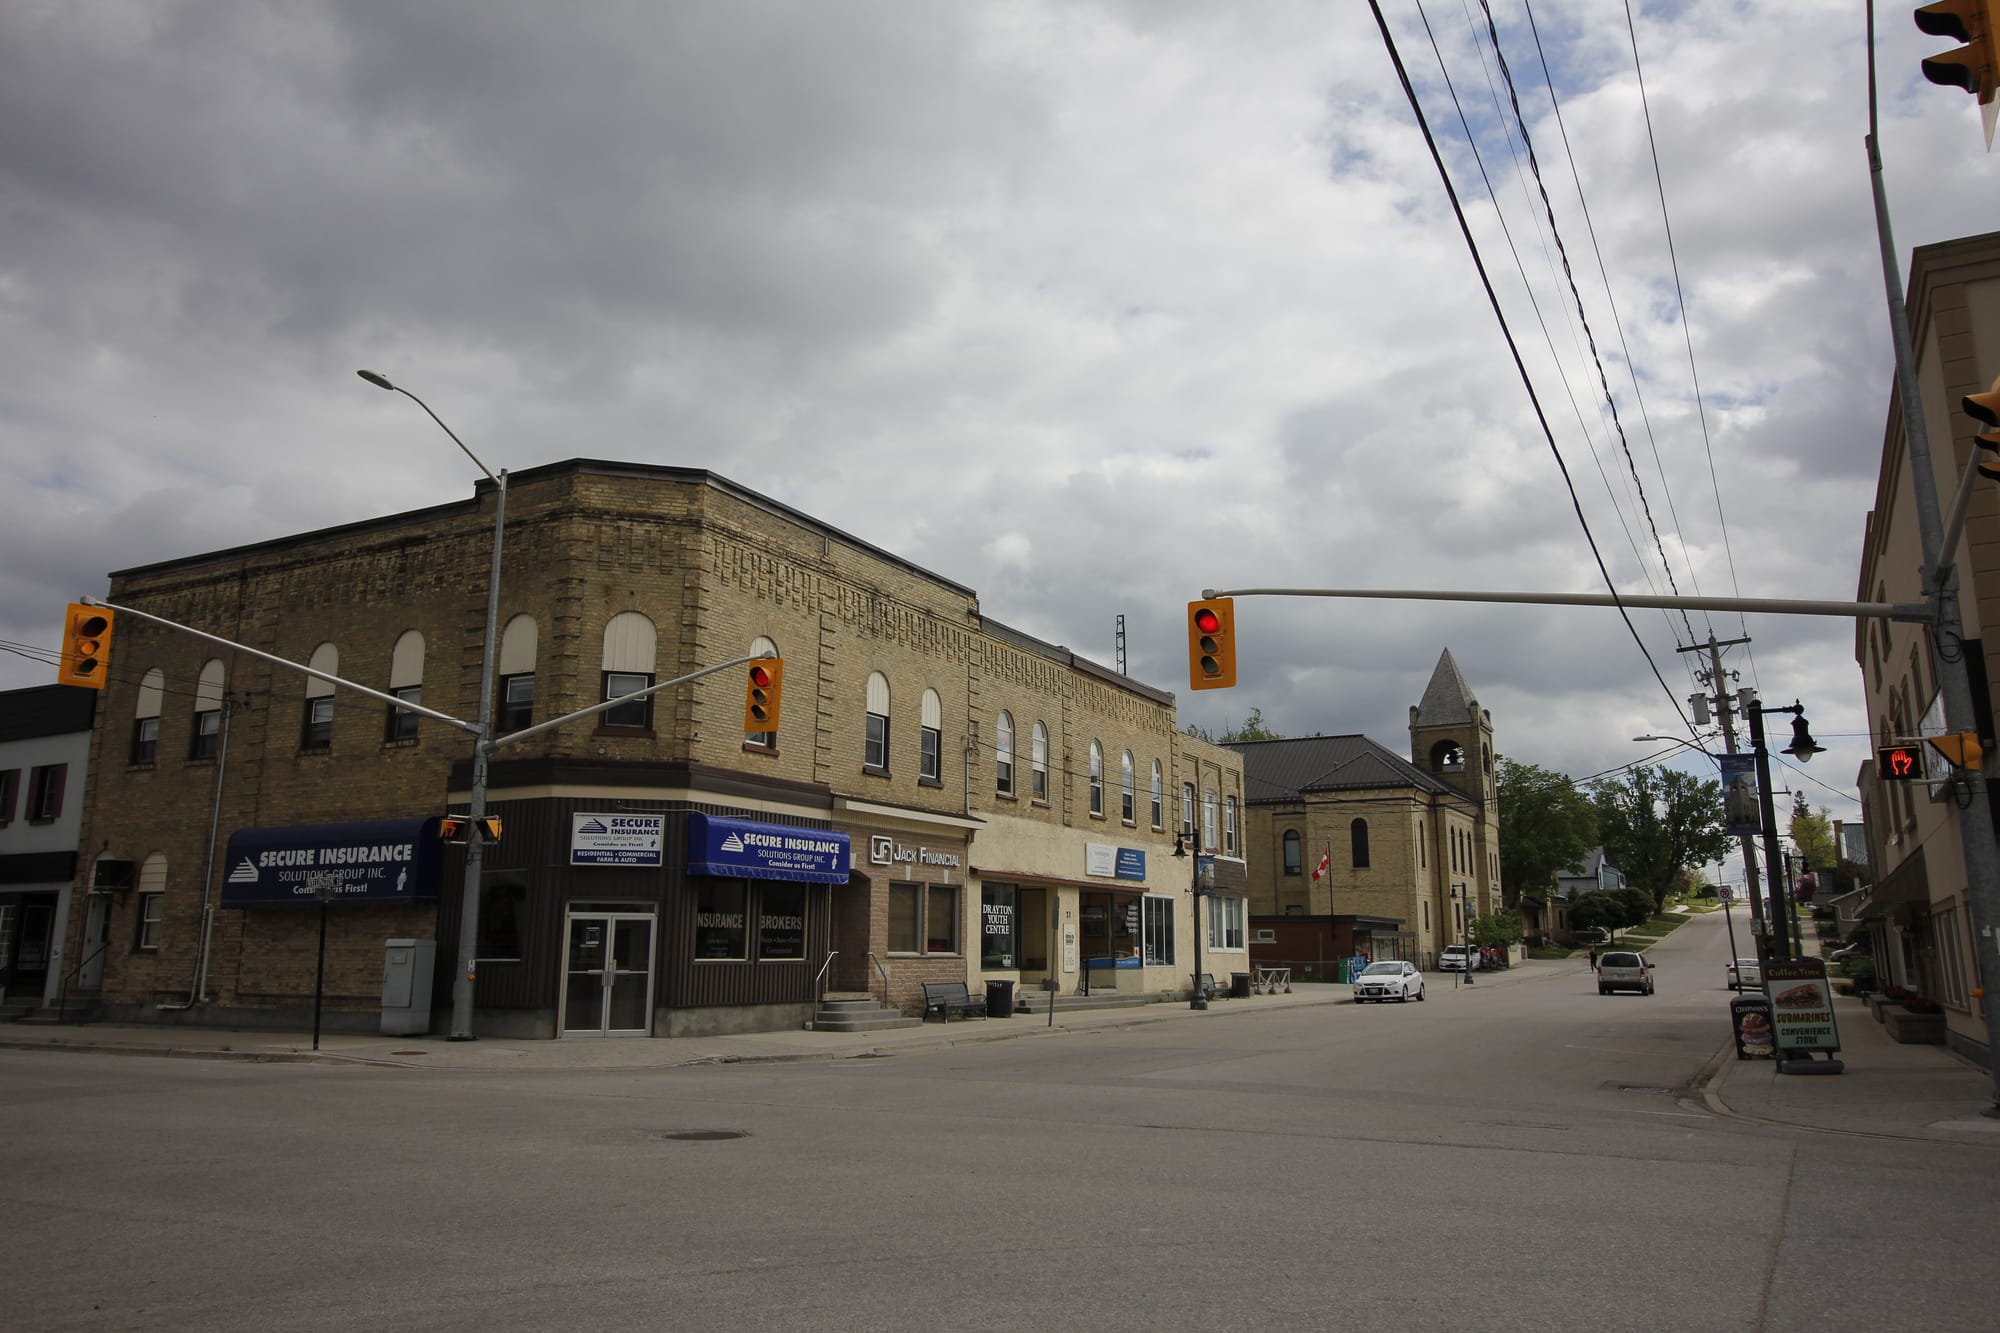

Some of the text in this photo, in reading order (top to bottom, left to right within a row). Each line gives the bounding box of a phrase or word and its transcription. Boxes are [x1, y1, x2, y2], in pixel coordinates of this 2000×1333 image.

[611, 818, 660, 828] SECURE
[743, 832, 840, 854] SECURE INSURANCE
[259, 843, 414, 867] SECURE INSURANCE
[758, 849, 792, 861] SOLUTIONS
[793, 853, 813, 862] GROUP
[768, 859, 793, 868] Consider
[367, 867, 387, 879] INC.
[344, 883, 368, 893] First!
[983, 904, 1013, 915] DRAYTON
[697, 911, 743, 929] NSURANCE
[760, 915, 802, 930] BROKERS
[988, 914, 1008, 924] YOUTH
[985, 925, 1010, 935] CENTRE
[1776, 1012, 1830, 1024] SUBMARINES
[1781, 1027, 1831, 1036] CONVENIENCE
